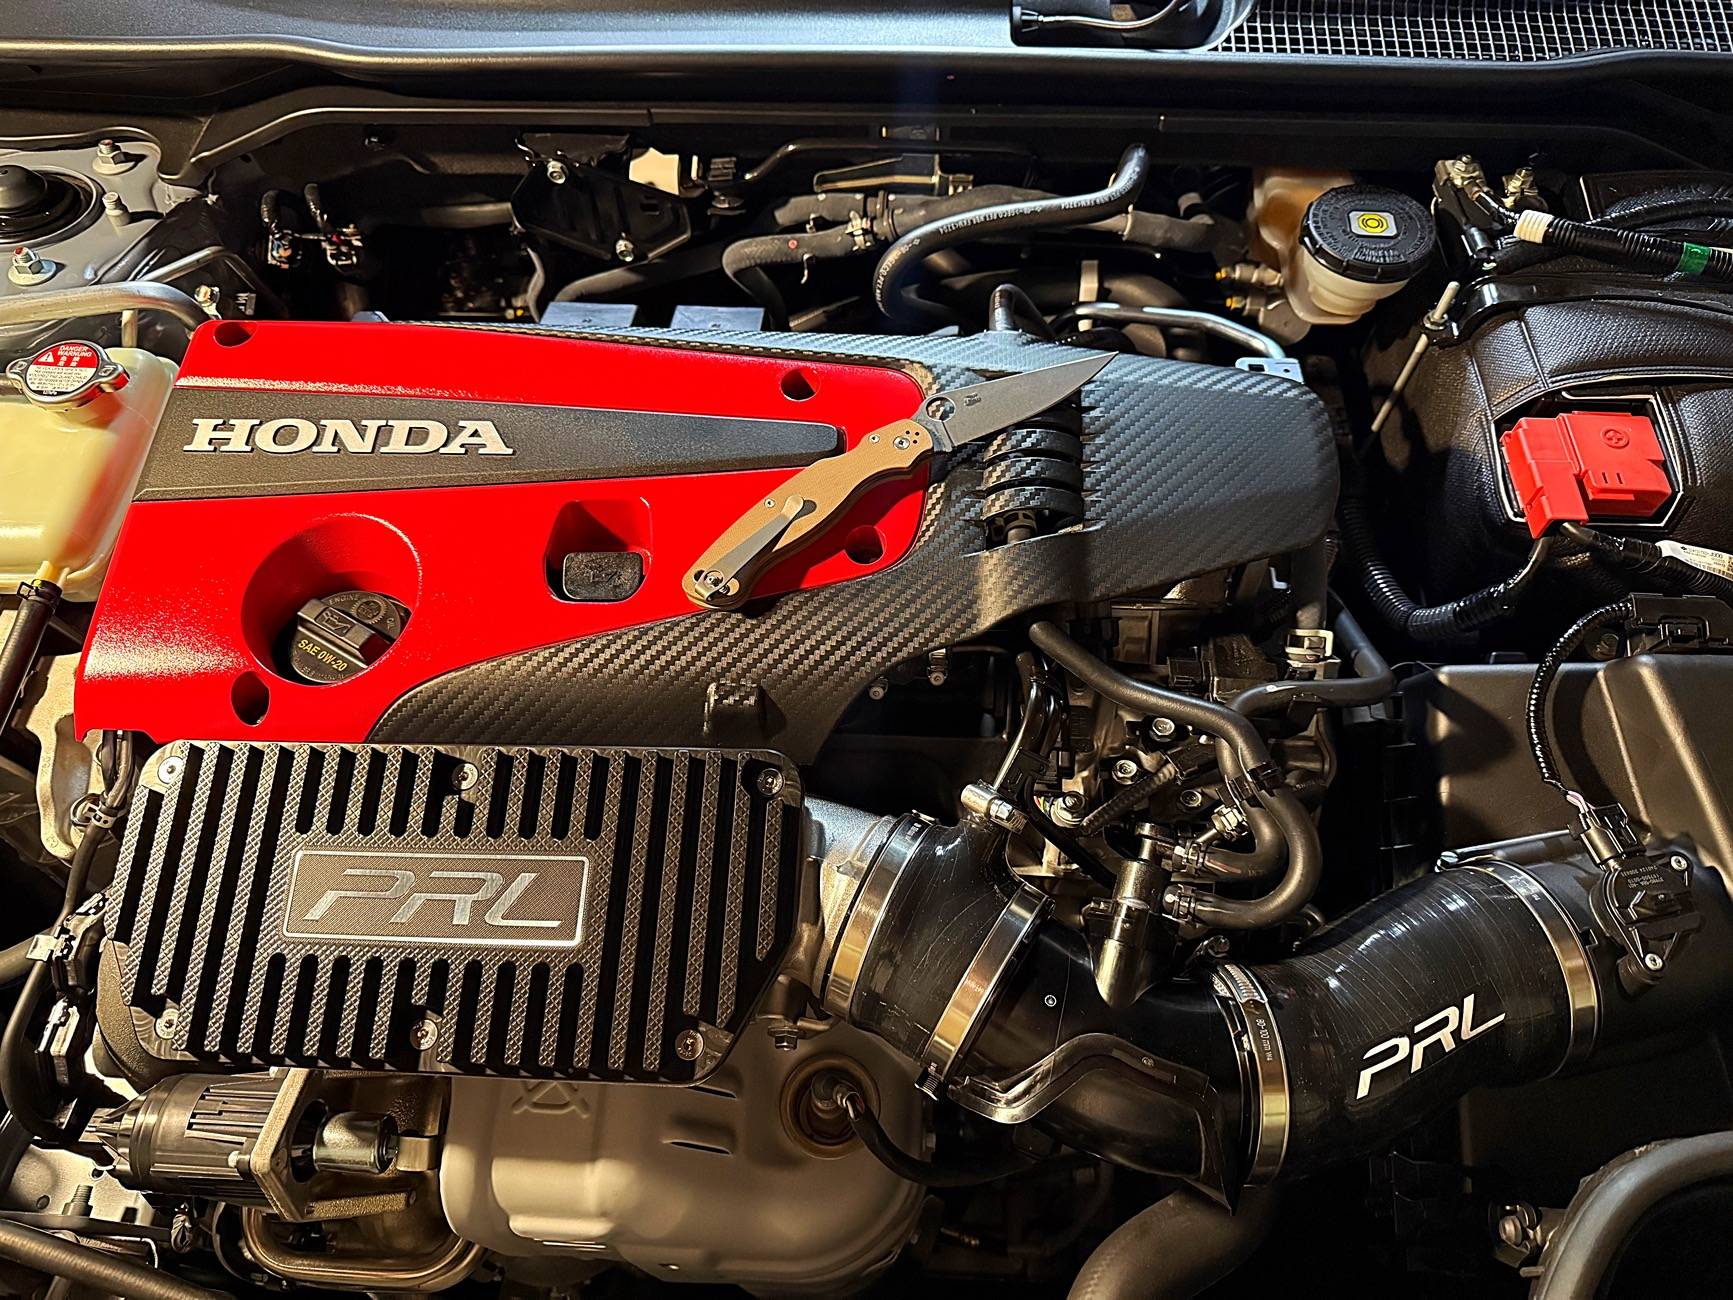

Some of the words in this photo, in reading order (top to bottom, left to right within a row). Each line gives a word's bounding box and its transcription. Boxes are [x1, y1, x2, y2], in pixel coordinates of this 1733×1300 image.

[183, 418, 514, 454] HONDA
[328, 594, 360, 605] ENGINE
[298, 639, 320, 656] SAE
[317, 650, 348, 672] 0W-20
[302, 868, 562, 928] PRL
[1356, 993, 1506, 1100] PRL
